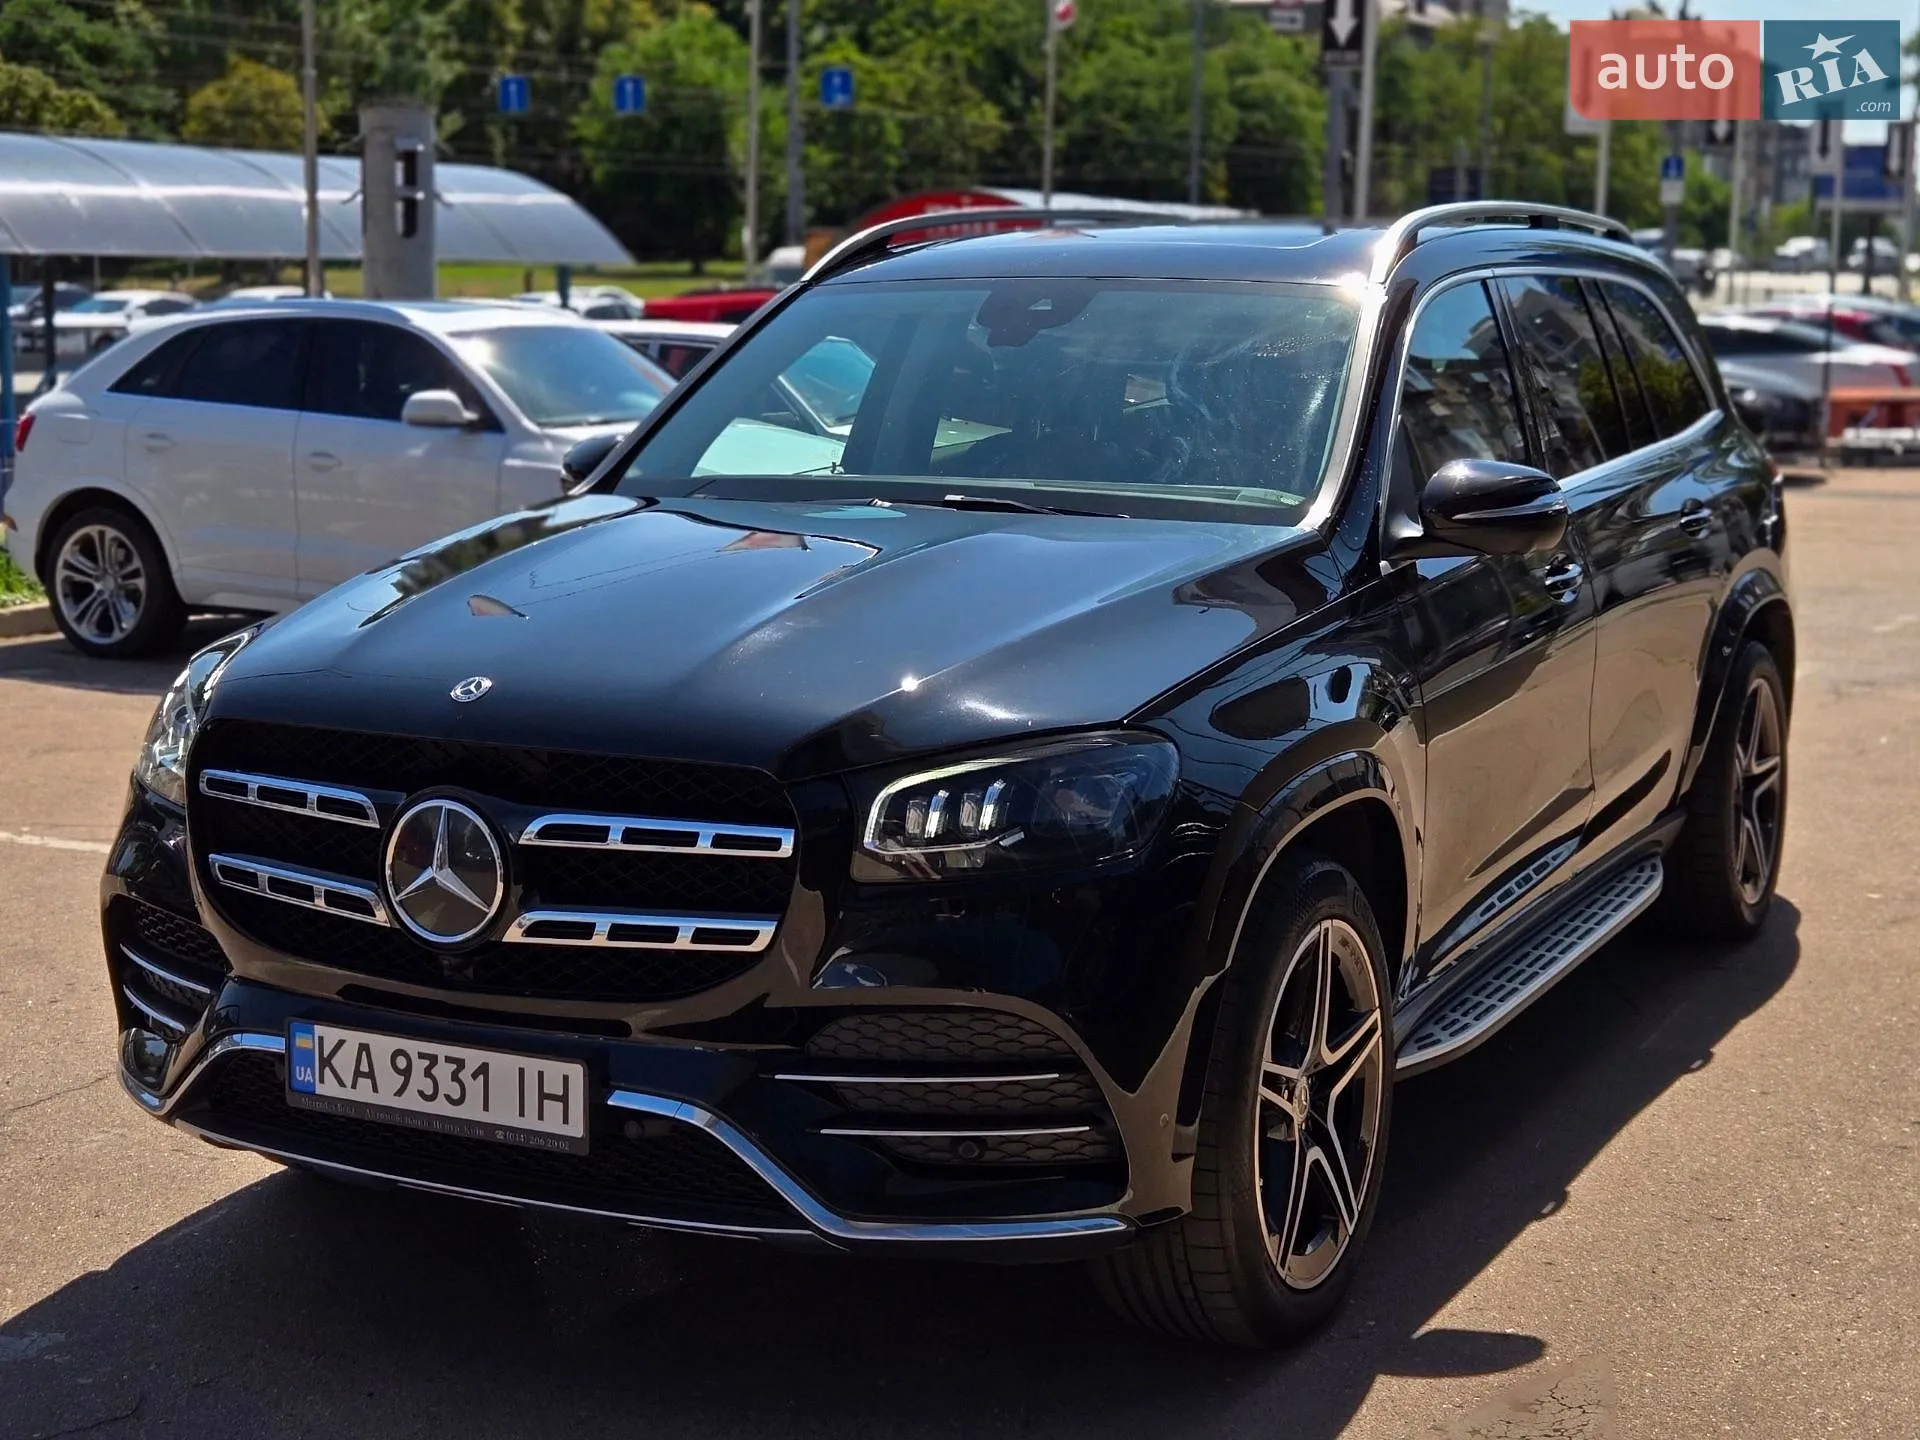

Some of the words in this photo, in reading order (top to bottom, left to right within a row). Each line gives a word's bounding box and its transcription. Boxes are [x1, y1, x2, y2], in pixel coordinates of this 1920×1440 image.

[296, 1065, 314, 1084] UA
[318, 1036, 379, 1094] KA
[390, 1048, 490, 1112] 9331
[518, 1067, 570, 1125] IH
